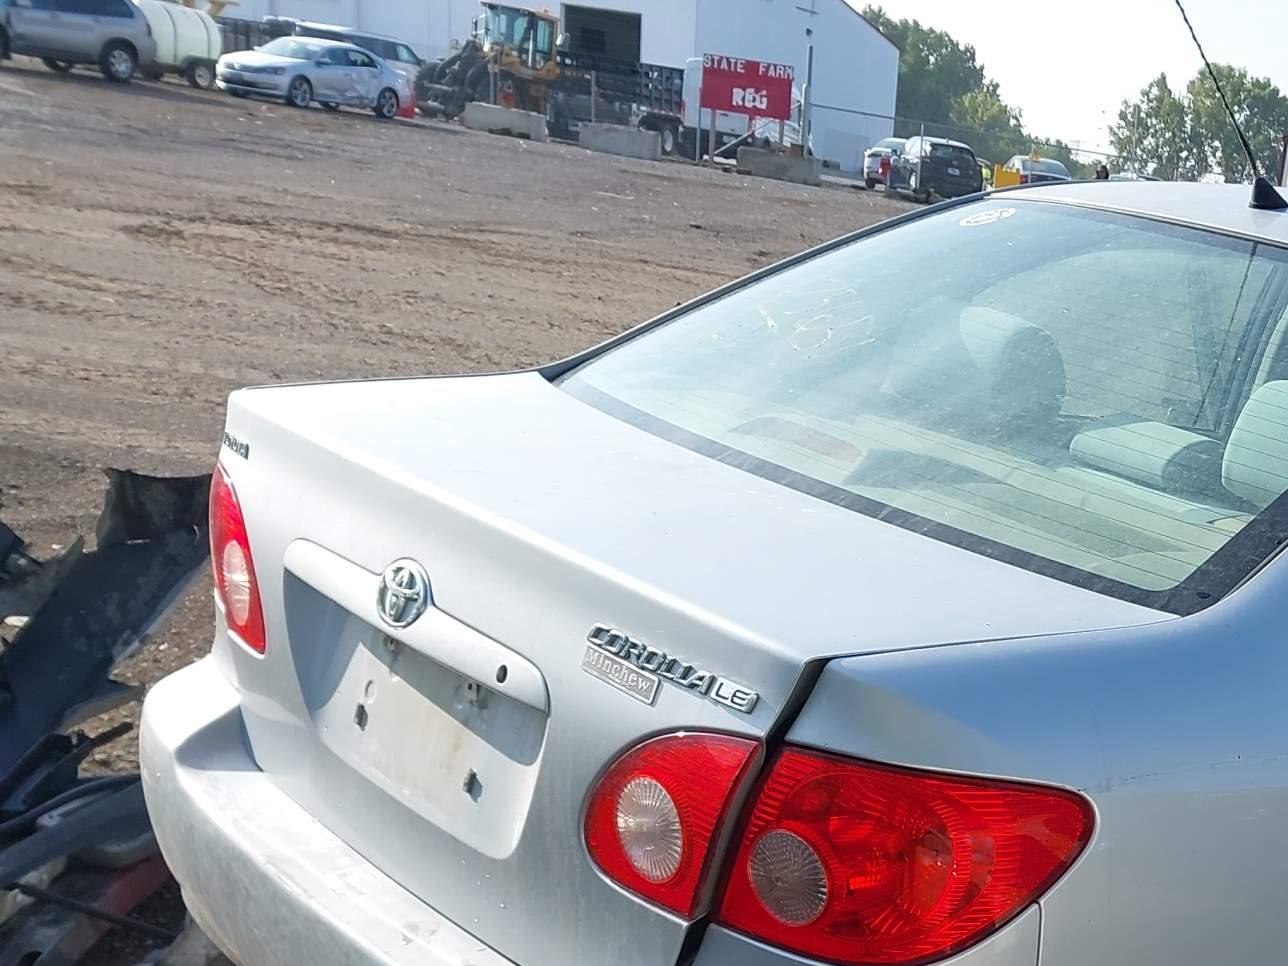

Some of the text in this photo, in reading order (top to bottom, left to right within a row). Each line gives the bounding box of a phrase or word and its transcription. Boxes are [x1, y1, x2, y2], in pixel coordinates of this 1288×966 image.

[703, 55, 794, 80] STATE FARM
[583, 648, 651, 691] Minchew
[586, 622, 754, 710] COROLLA LE
